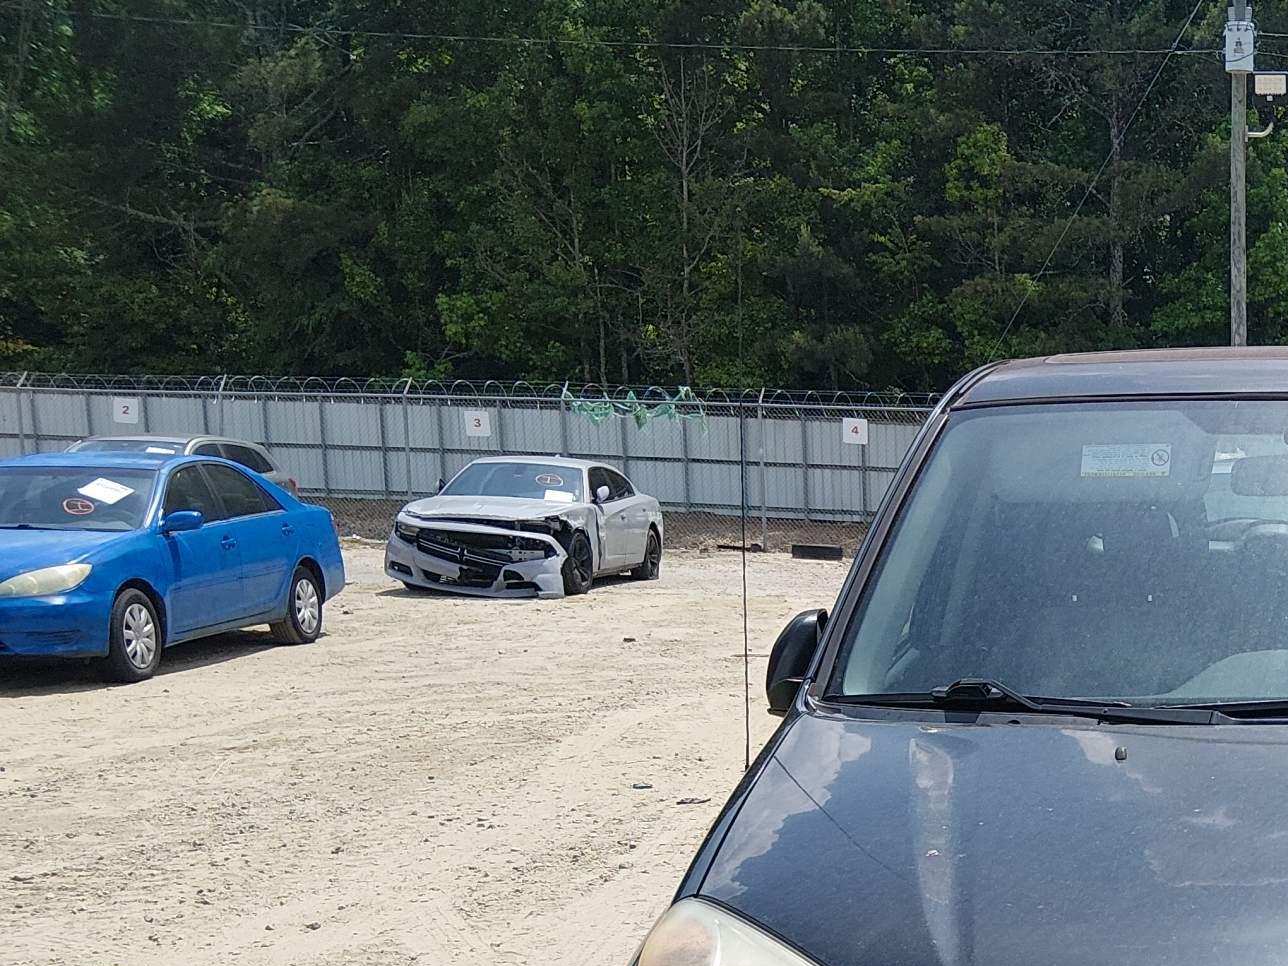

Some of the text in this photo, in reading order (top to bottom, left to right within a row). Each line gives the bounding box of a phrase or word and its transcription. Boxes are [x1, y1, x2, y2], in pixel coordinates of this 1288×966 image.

[122, 405, 129, 415] 2
[474, 418, 481, 428] 3
[851, 425, 860, 435] 4
